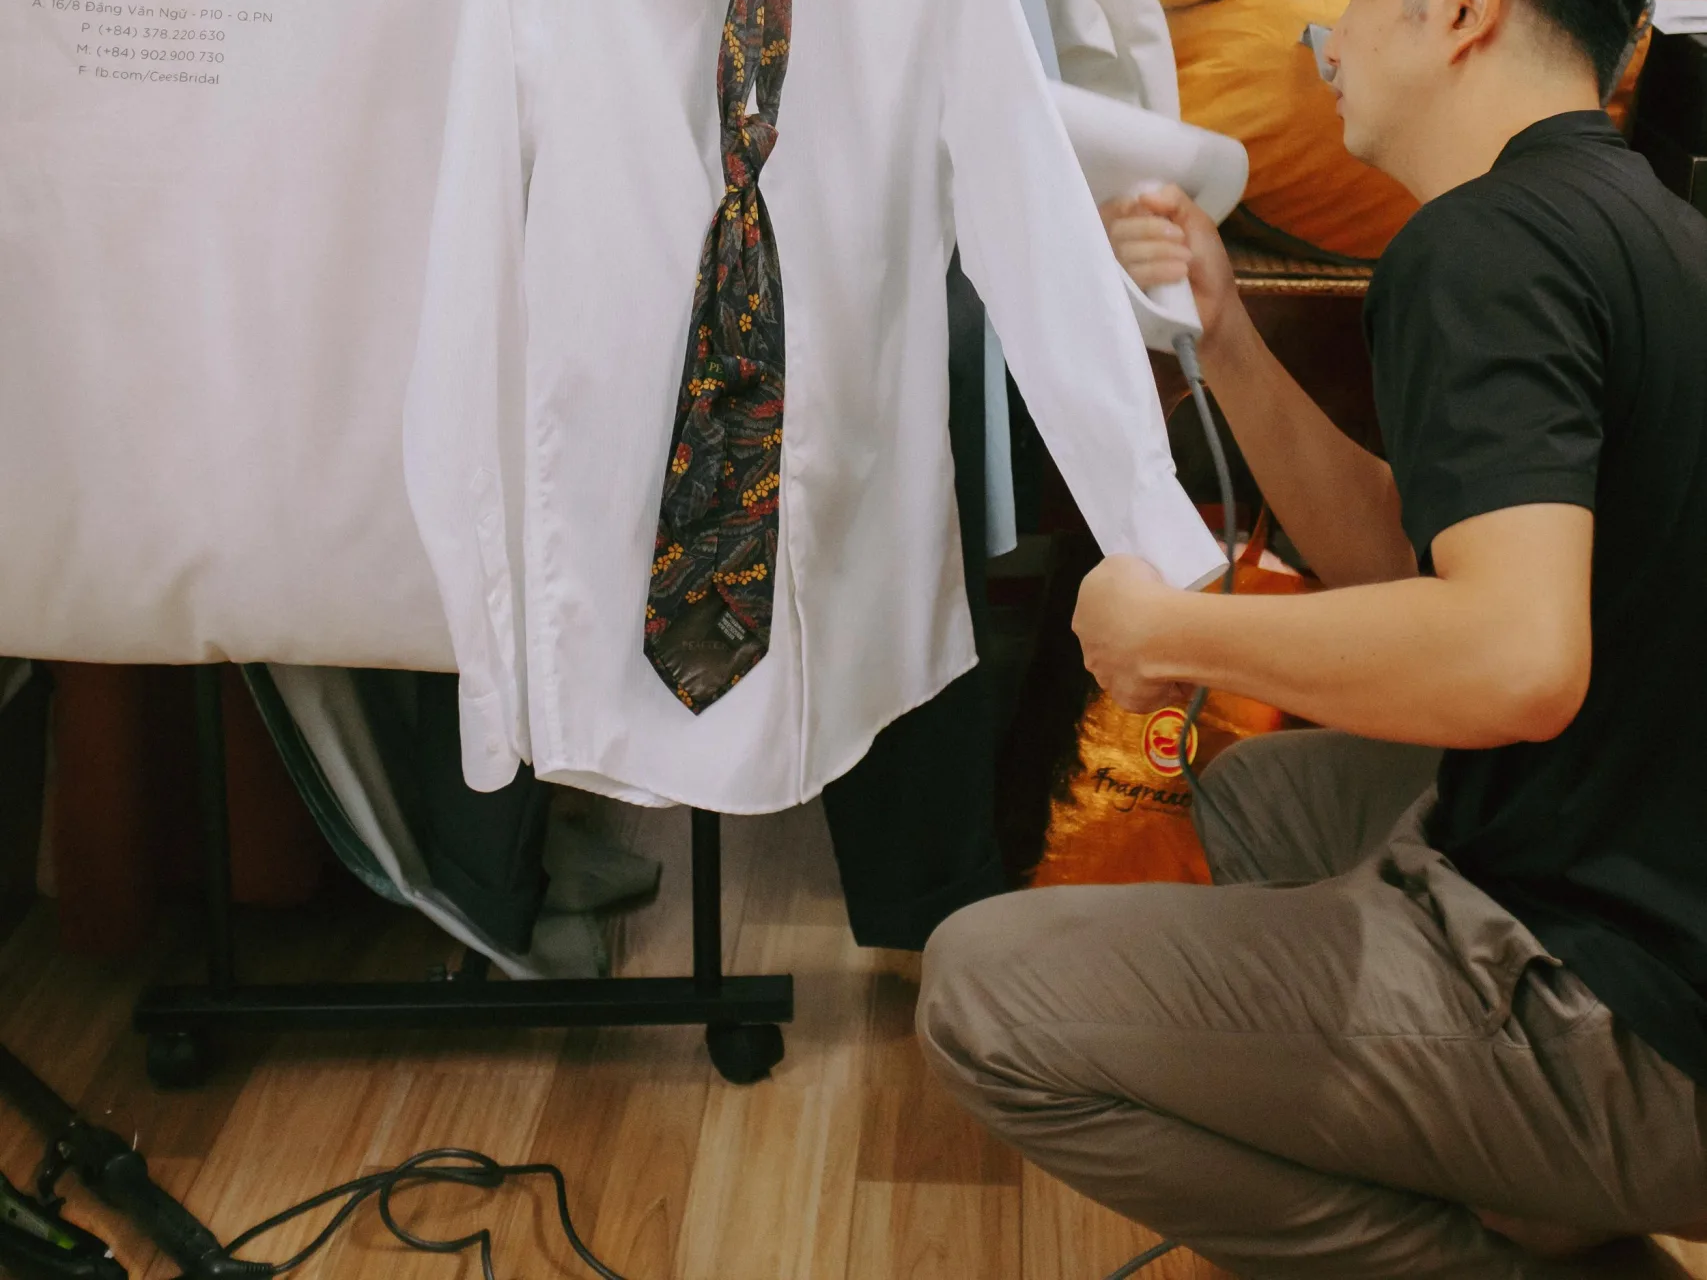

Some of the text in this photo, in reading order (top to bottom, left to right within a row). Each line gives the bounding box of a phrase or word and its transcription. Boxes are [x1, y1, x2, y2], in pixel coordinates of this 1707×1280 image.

[98, 24, 138, 39] (+84)
[142, 27, 225, 42] 378.220.630
[96, 45, 136, 60] (+84)
[95, 66, 220, 85] fb.com/CeesBridal
